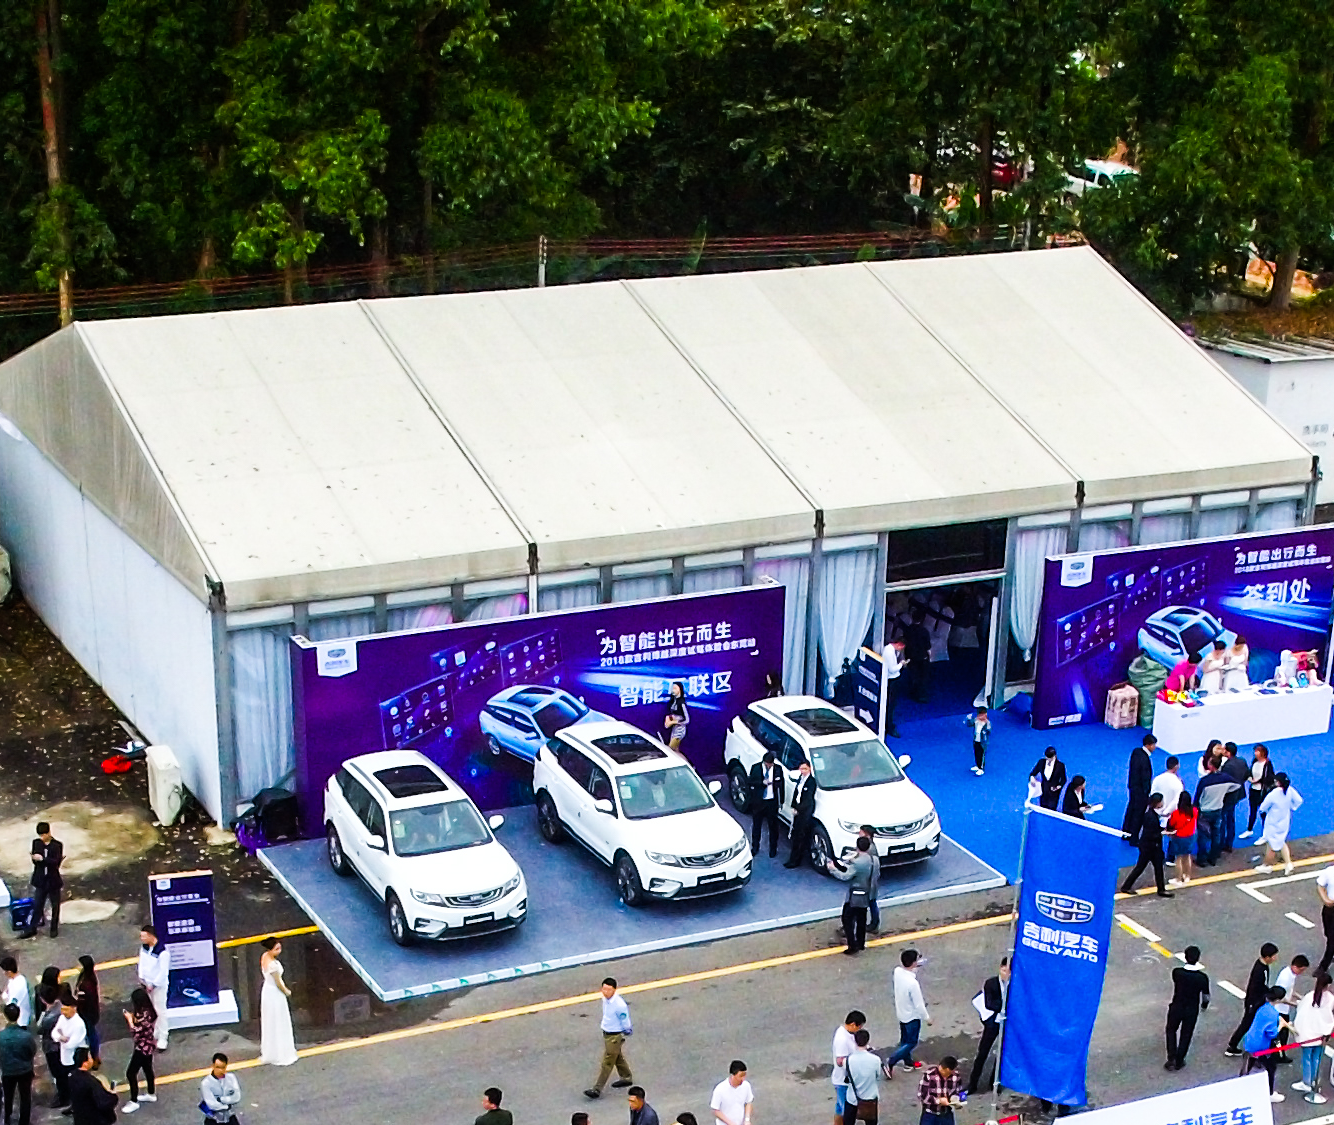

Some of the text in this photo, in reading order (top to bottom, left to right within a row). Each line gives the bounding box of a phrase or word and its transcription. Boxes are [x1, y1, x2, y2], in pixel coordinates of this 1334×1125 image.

[1242, 577, 1311, 608] 签到处
[600, 621, 732, 655] 为智能出行而生
[1022, 937, 1098, 963] GEELY AUTO
[1023, 921, 1099, 953] 吉利汽车
